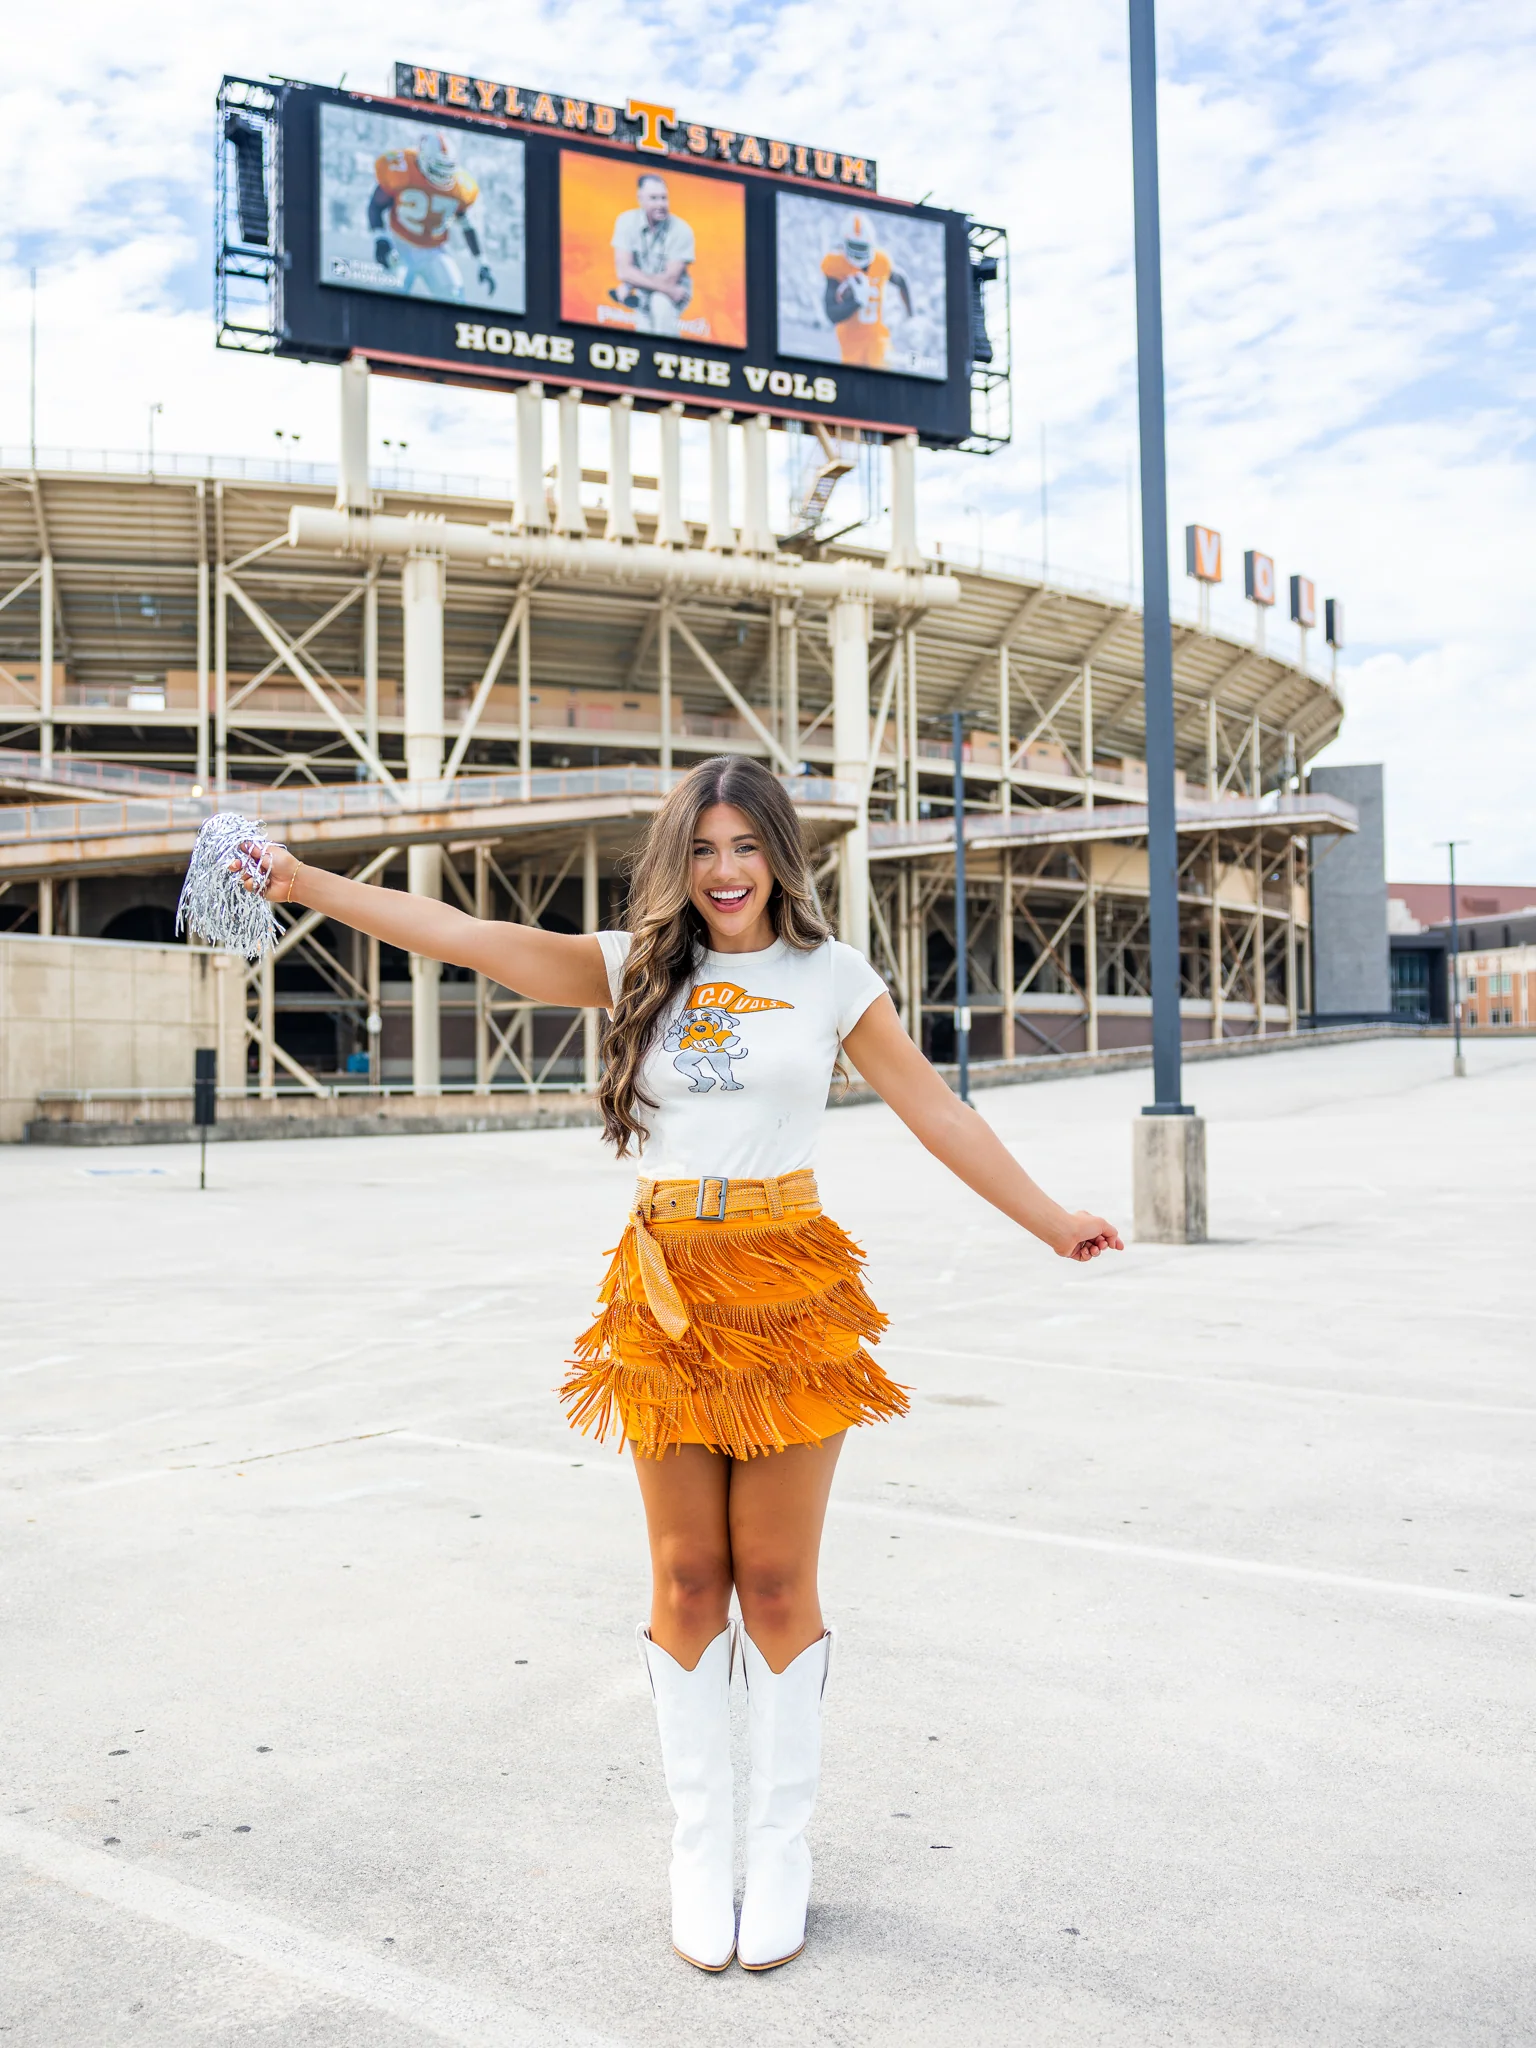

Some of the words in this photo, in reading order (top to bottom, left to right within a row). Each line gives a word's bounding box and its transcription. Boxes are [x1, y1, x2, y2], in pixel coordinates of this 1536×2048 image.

[413, 66, 617, 136] NEYLAND
[626, 98, 676, 155] T
[686, 124, 870, 187] STADIUM
[455, 322, 575, 364] HOME
[589, 342, 640, 372] OF
[653, 352, 730, 387] THE
[743, 365, 838, 403] VOLS
[698, 987, 735, 1006] GO
